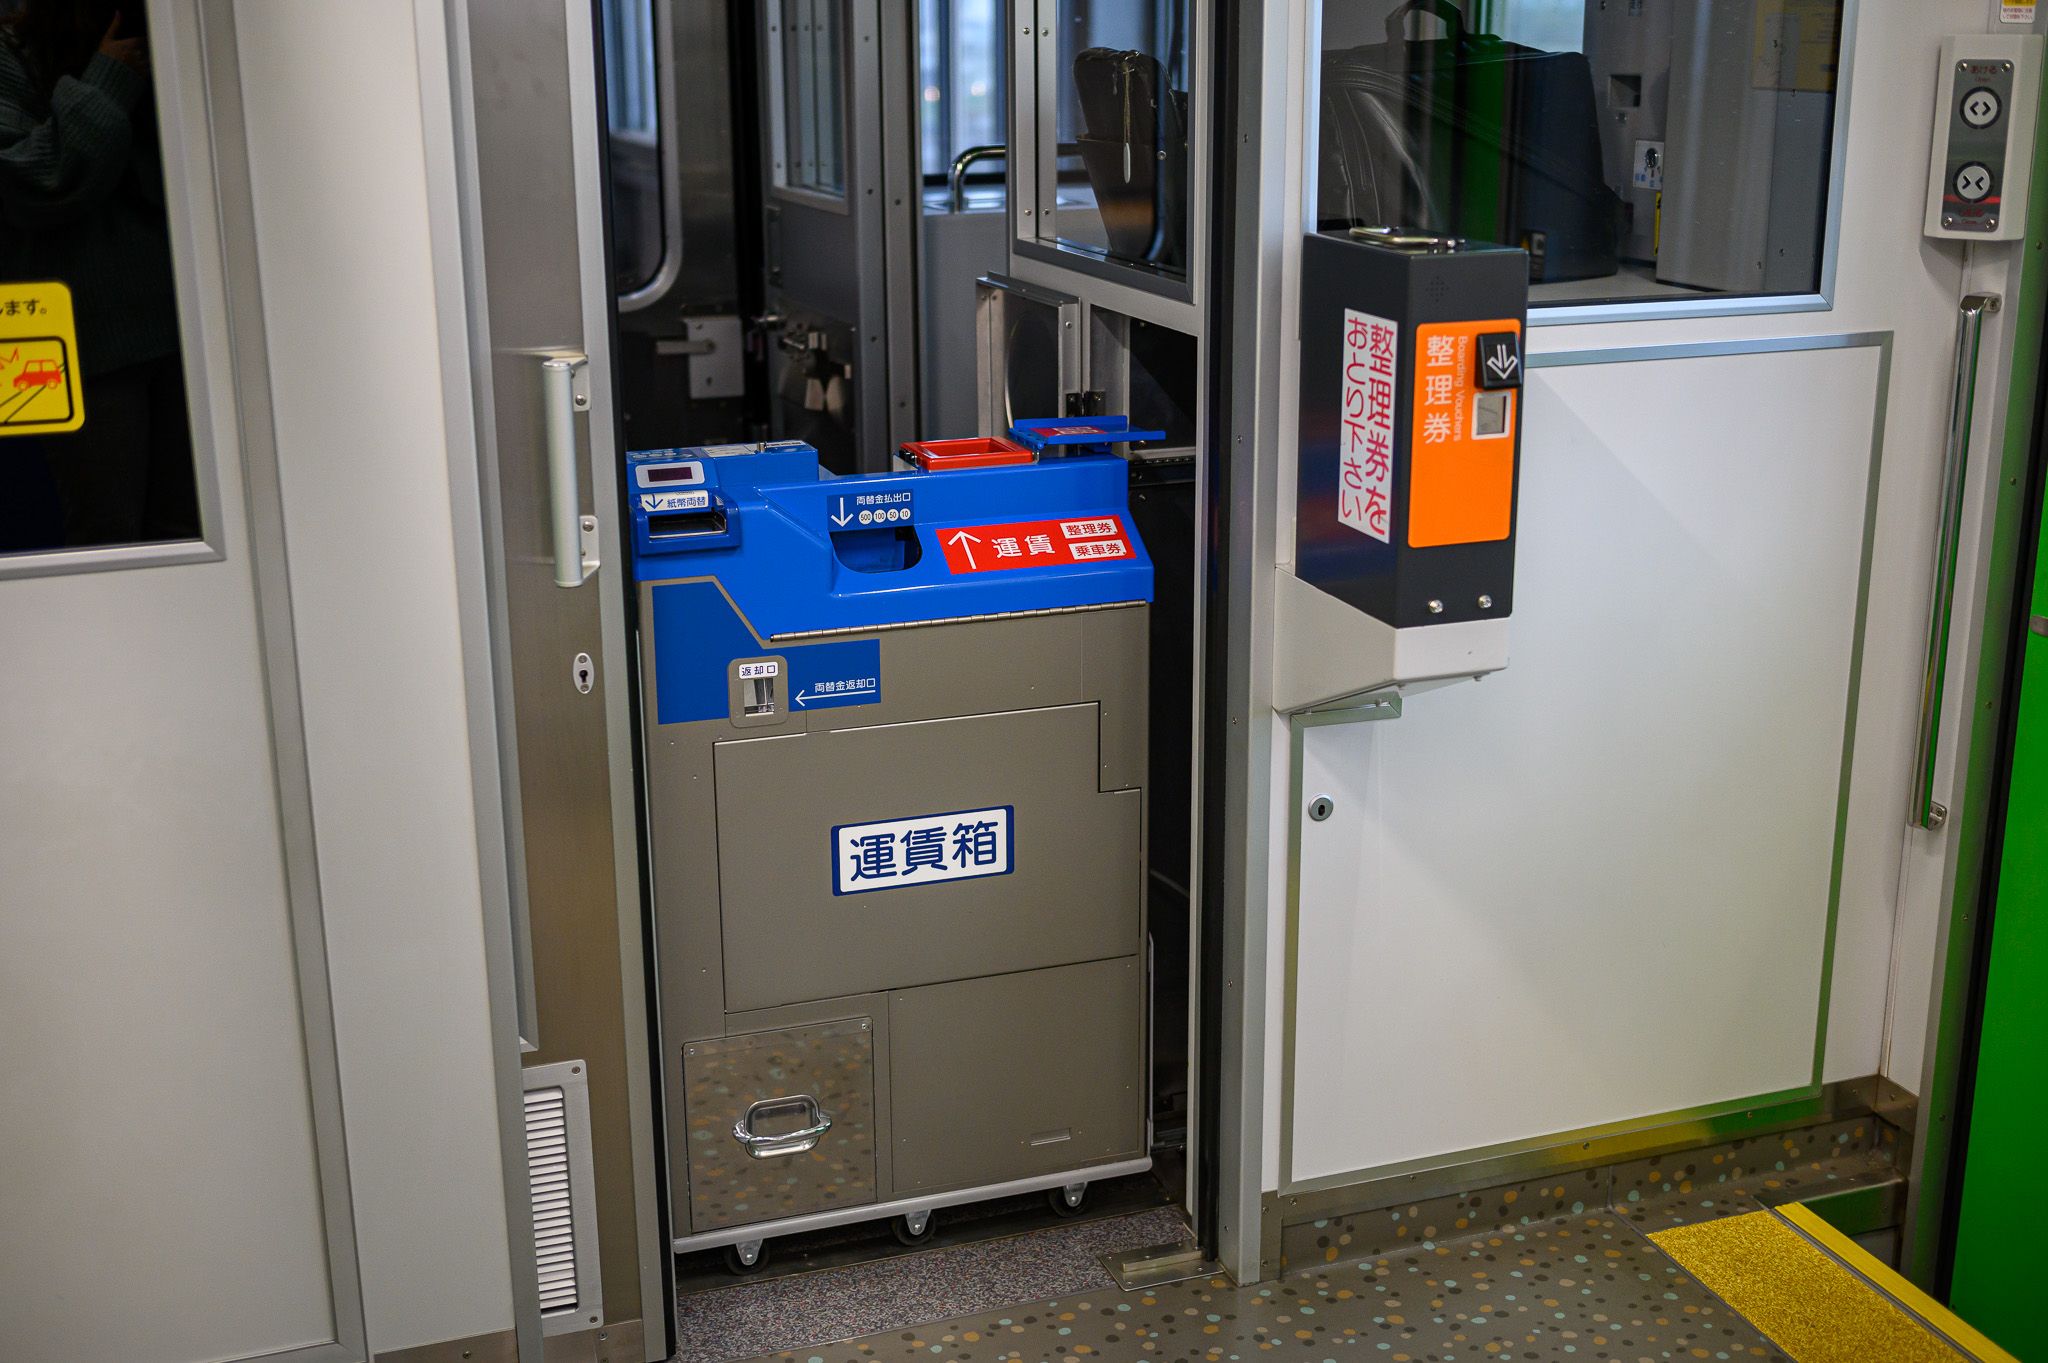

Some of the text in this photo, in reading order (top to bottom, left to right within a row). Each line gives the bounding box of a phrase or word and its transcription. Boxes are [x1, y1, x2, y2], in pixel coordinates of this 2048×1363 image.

[0, 298, 47, 316] ます。
[1423, 335, 1455, 444] 整理券
[1453, 335, 1469, 442] Boarding Vouchers
[1341, 316, 1368, 522] おとり下さい
[1364, 324, 1394, 536] 整理券を
[667, 496, 706, 509] 紙幣両替
[856, 492, 911, 506] 両替金払出口
[875, 512, 885, 520] 100
[889, 511, 897, 519] 50
[901, 510, 909, 518] 10
[1066, 522, 1113, 536] 整理券
[991, 534, 1056, 559] 運賃
[1075, 543, 1122, 557] 乗車券
[741, 665, 776, 677] 返却口
[814, 677, 876, 693] 両替金返却口
[850, 820, 999, 882] 運賃箱
